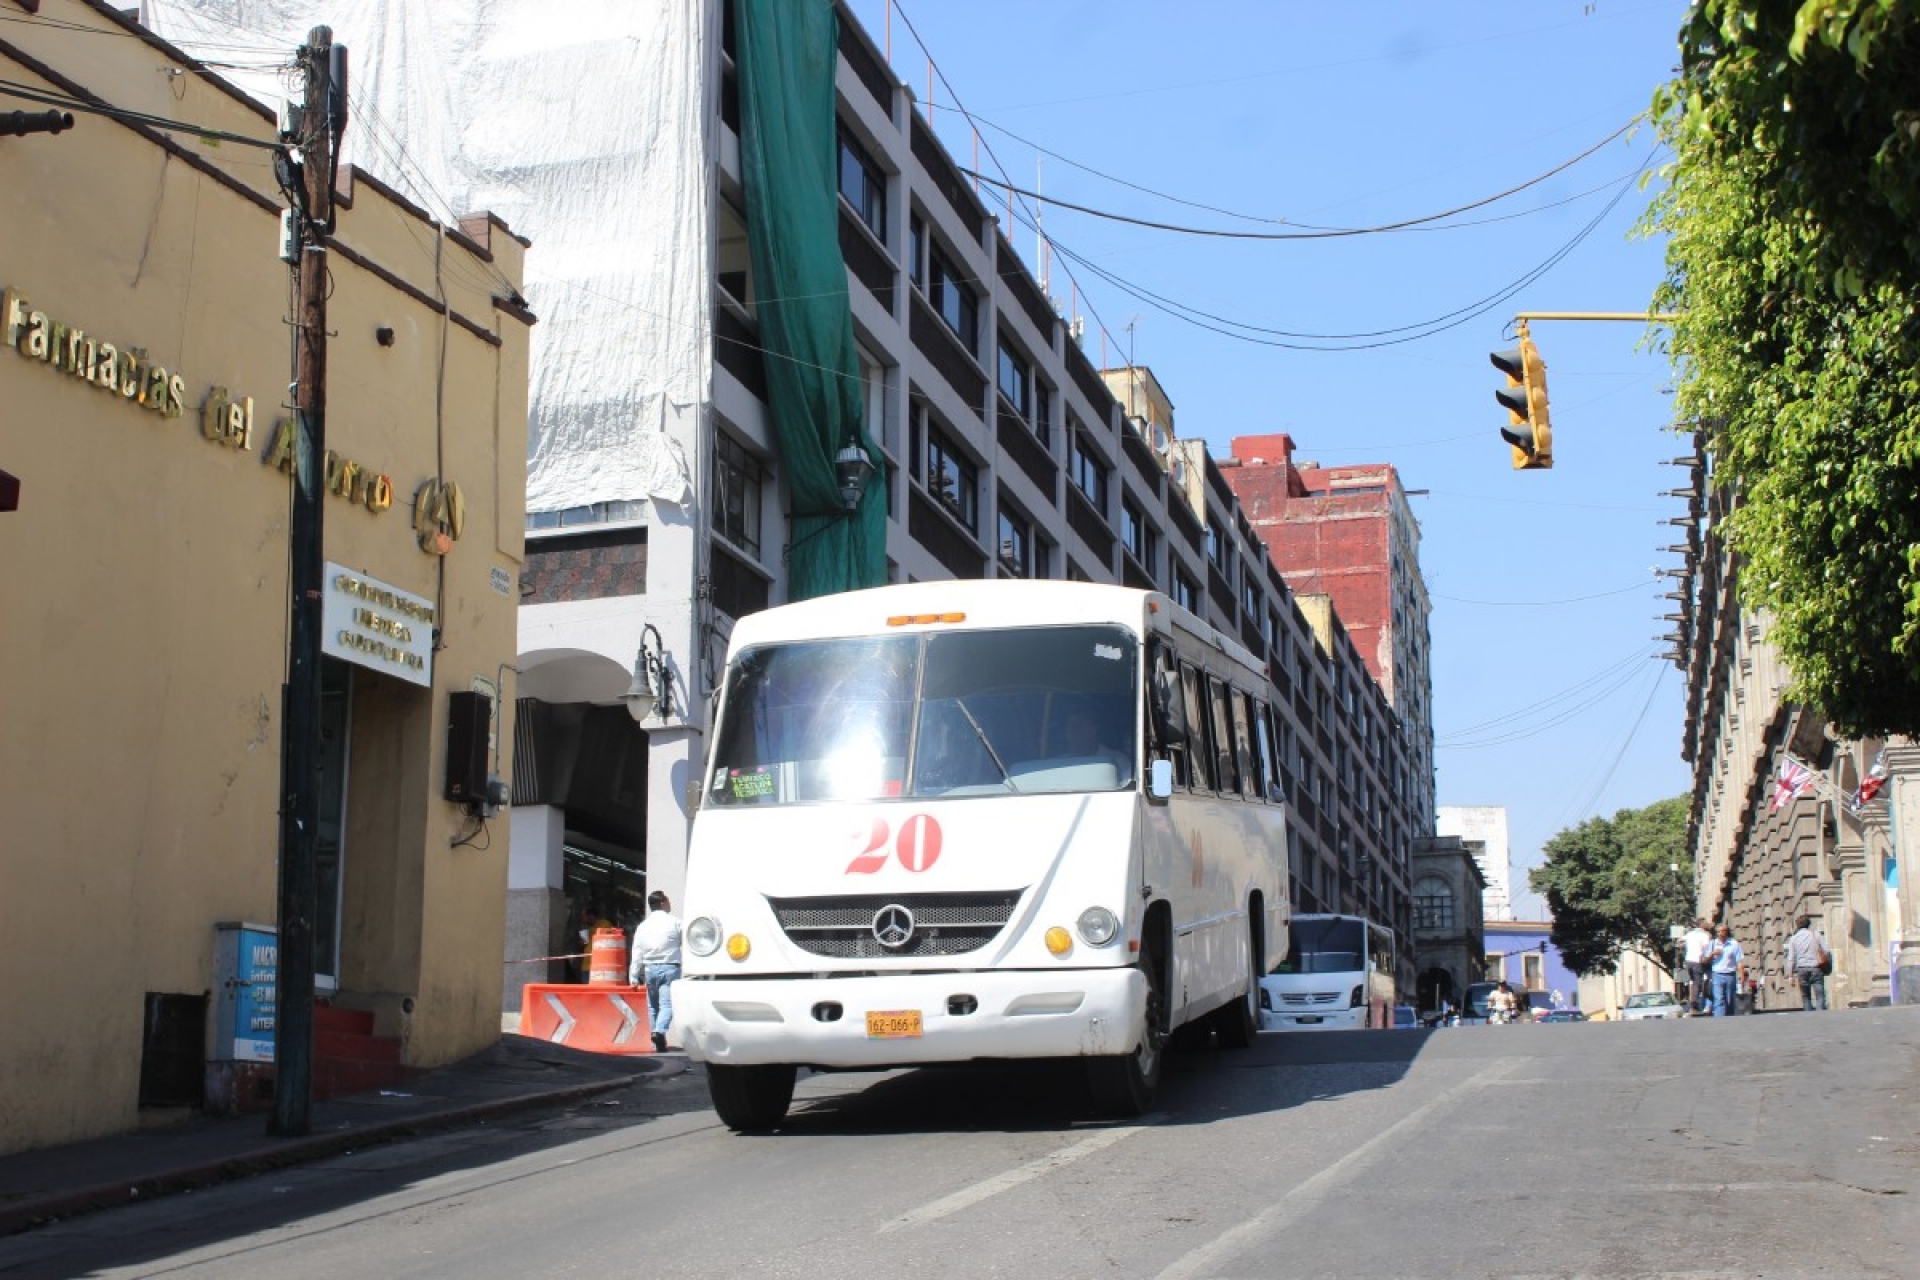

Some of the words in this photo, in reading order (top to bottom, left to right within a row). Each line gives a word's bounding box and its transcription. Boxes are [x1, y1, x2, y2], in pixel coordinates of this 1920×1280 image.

[2, 284, 185, 418] Farmacias
[203, 385, 254, 450] del
[262, 415, 392, 513] Aorro
[845, 814, 943, 876] 20
[250, 970, 276, 982] infini
[250, 1017, 276, 1031] INTER
